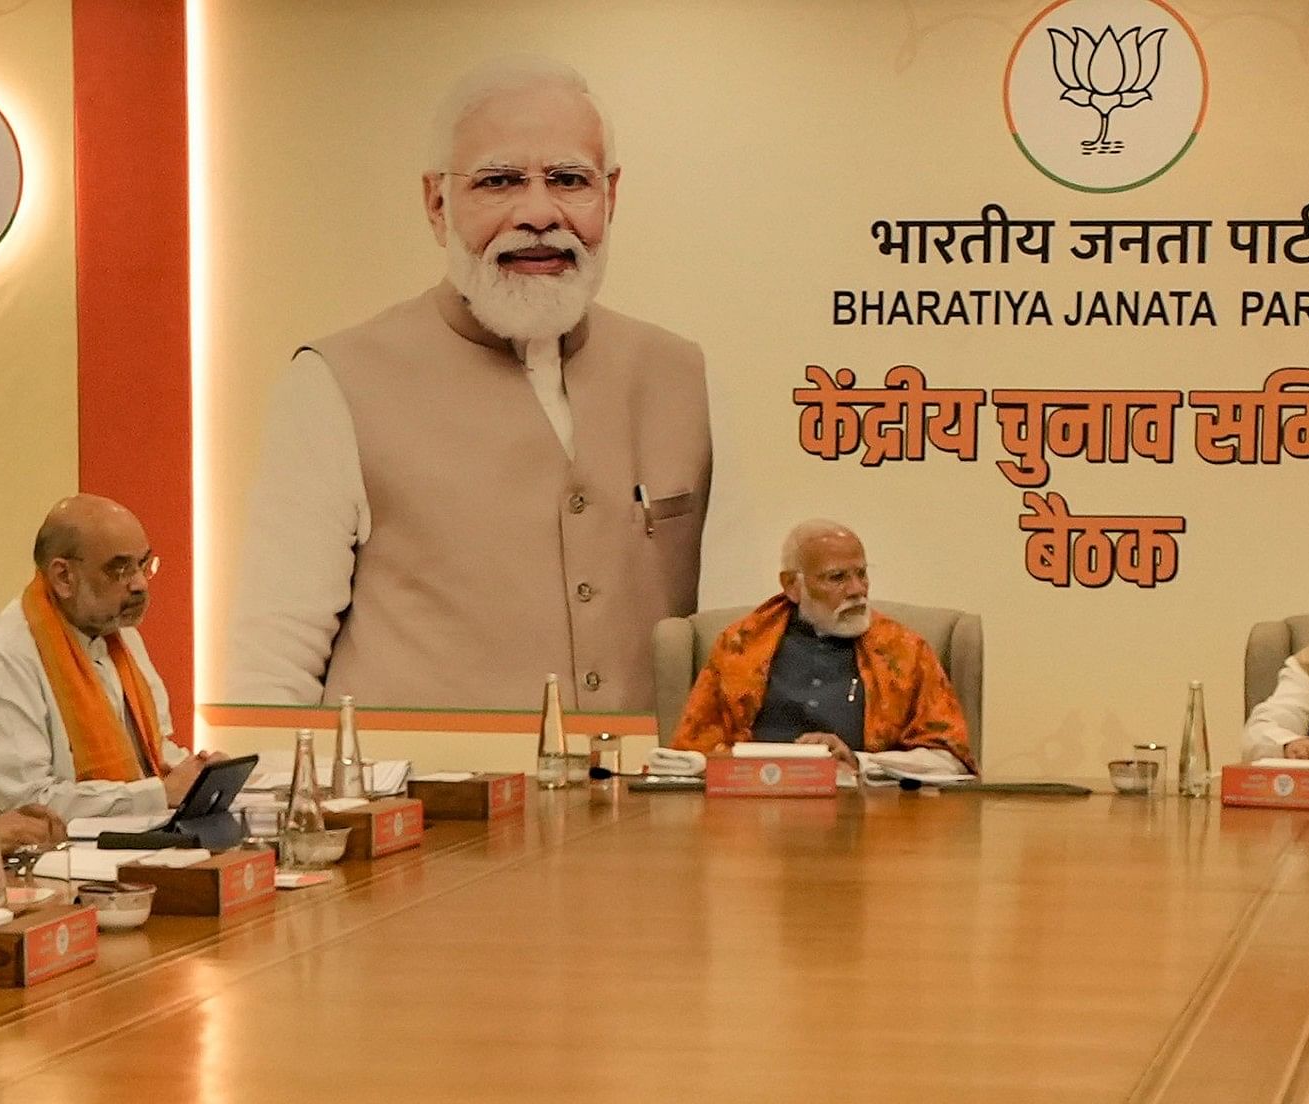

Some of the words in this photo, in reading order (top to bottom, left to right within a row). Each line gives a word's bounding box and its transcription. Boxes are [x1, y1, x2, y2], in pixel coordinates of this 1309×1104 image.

[871, 204, 1055, 264] भारतीय
[1070, 220, 1212, 264] जनता
[834, 291, 1052, 325] BHARATIYA
[1064, 291, 1217, 326] JANATA
[793, 365, 987, 467] केंद्रीय
[992, 389, 1184, 488] चुनाव
[1018, 490, 1186, 588] बैठक
